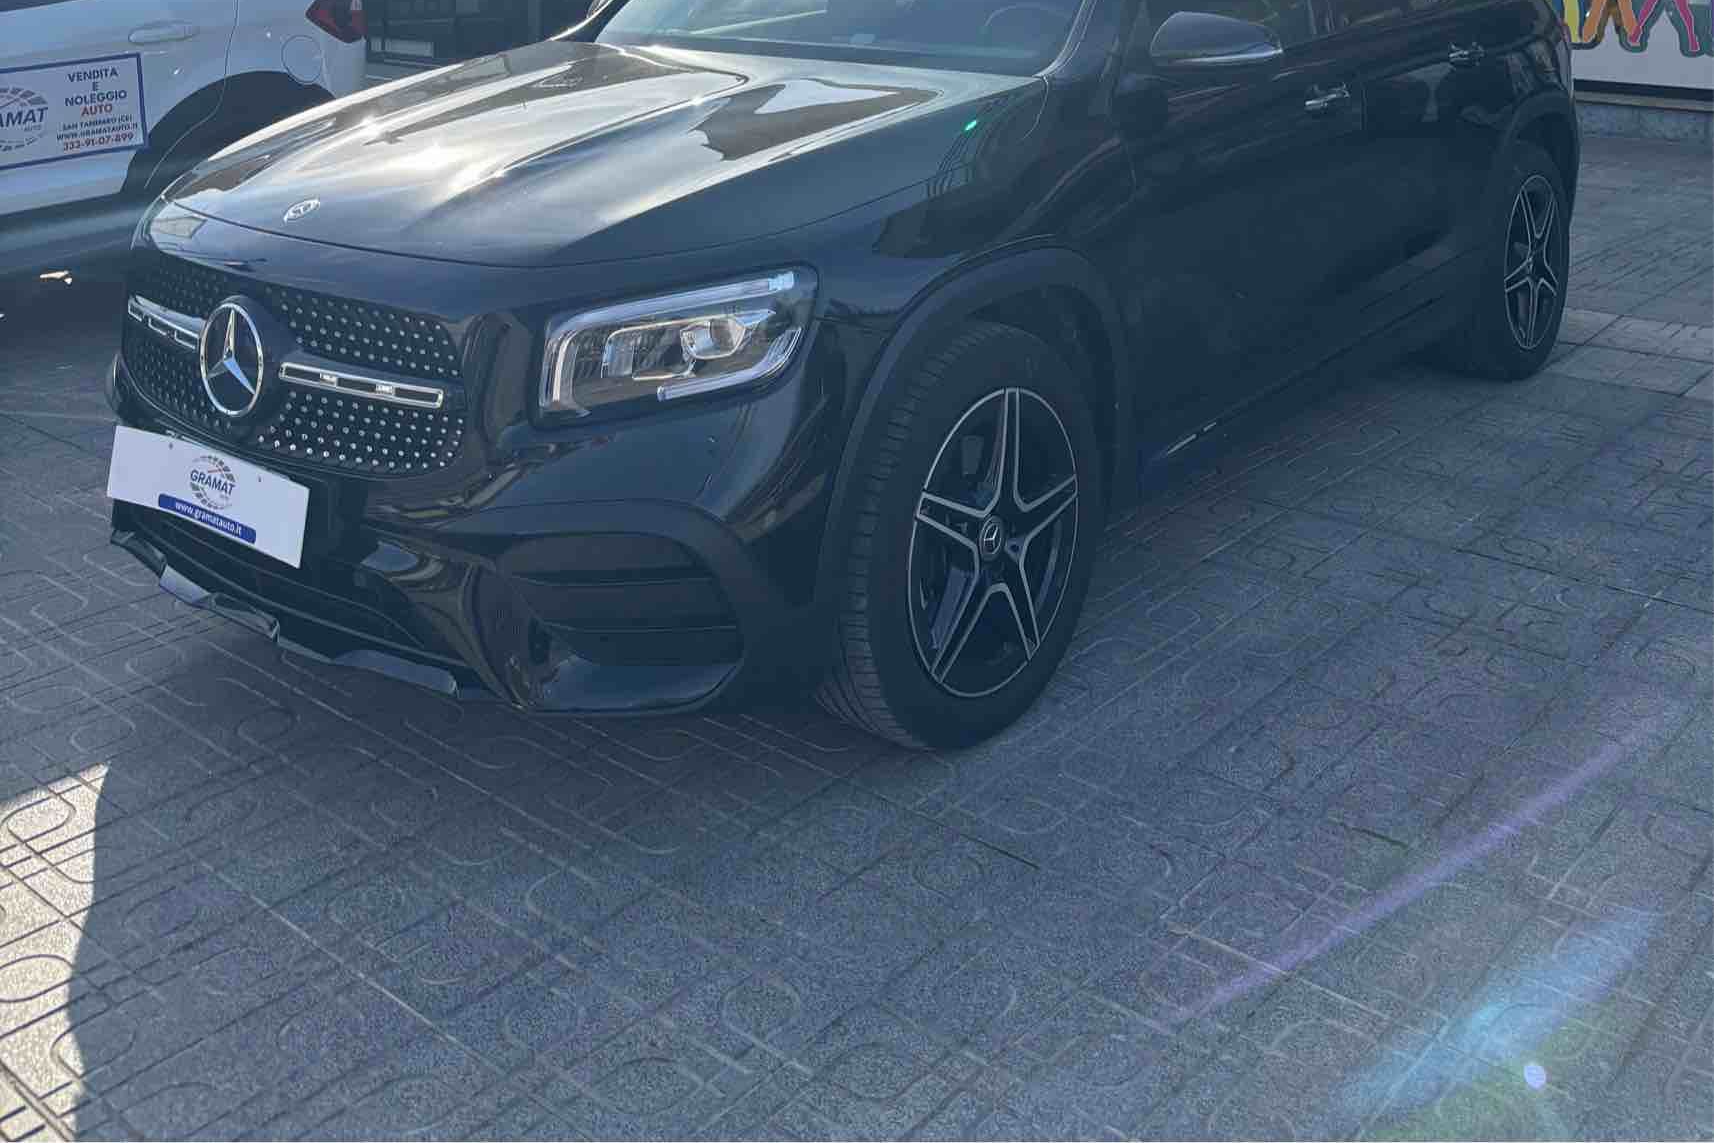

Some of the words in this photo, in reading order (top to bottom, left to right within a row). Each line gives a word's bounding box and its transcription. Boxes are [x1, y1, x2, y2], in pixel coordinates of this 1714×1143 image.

[67, 67, 119, 82] VENDITA
[92, 82, 99, 91] E
[64, 89, 127, 106] NOLEGGIO
[81, 103, 113, 116] AUTO
[191, 469, 236, 496] GRAMAT
[175, 501, 242, 537] www.gramatauto.it
